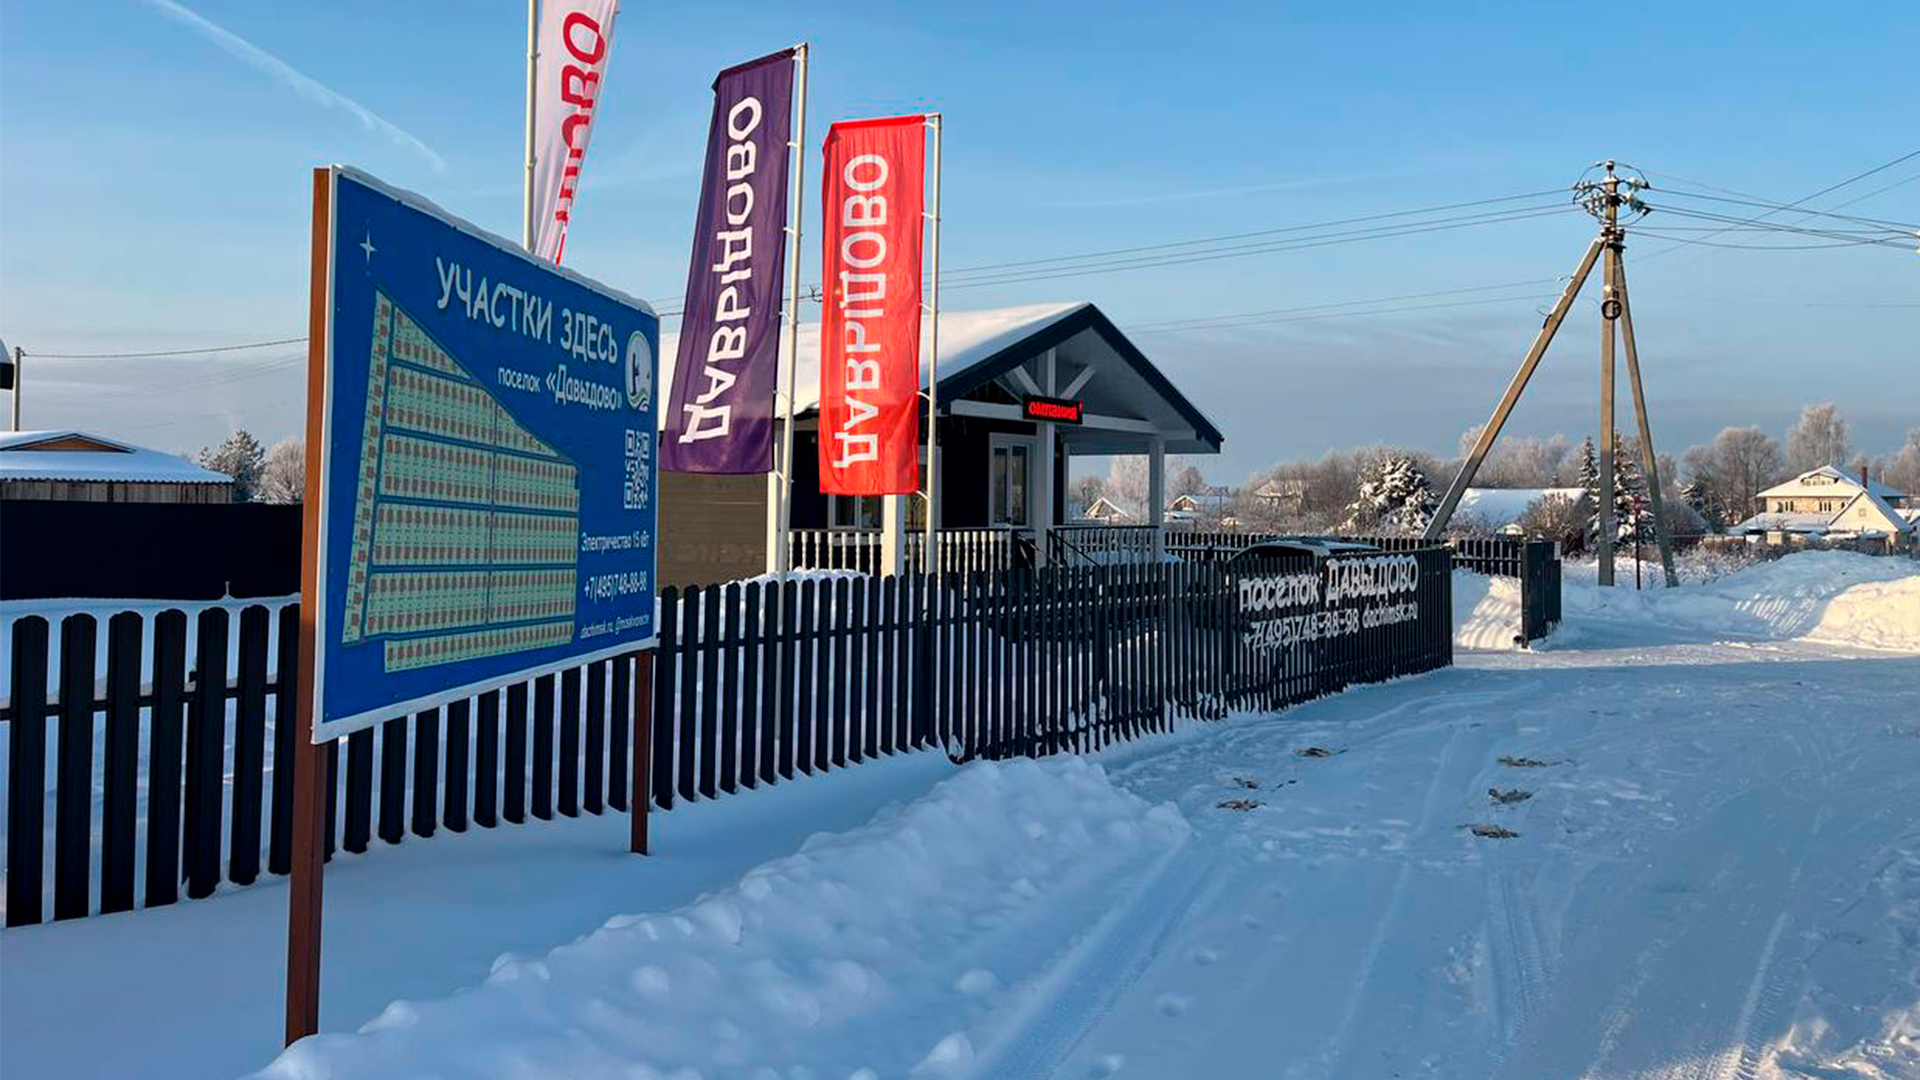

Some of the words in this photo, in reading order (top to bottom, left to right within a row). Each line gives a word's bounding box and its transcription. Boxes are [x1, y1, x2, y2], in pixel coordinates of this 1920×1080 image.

[436, 256, 552, 344] УЧАСТКИ
[560, 308, 618, 364] ЗДЕСЬ
[498, 367, 541, 393] поселок
[546, 364, 622, 410] «Давыдово»
[581, 532, 632, 554] Электричество
[633, 531, 640, 548] 15
[1239, 573, 1319, 614] поселок
[1325, 554, 1419, 608] ДАВЫДОВО
